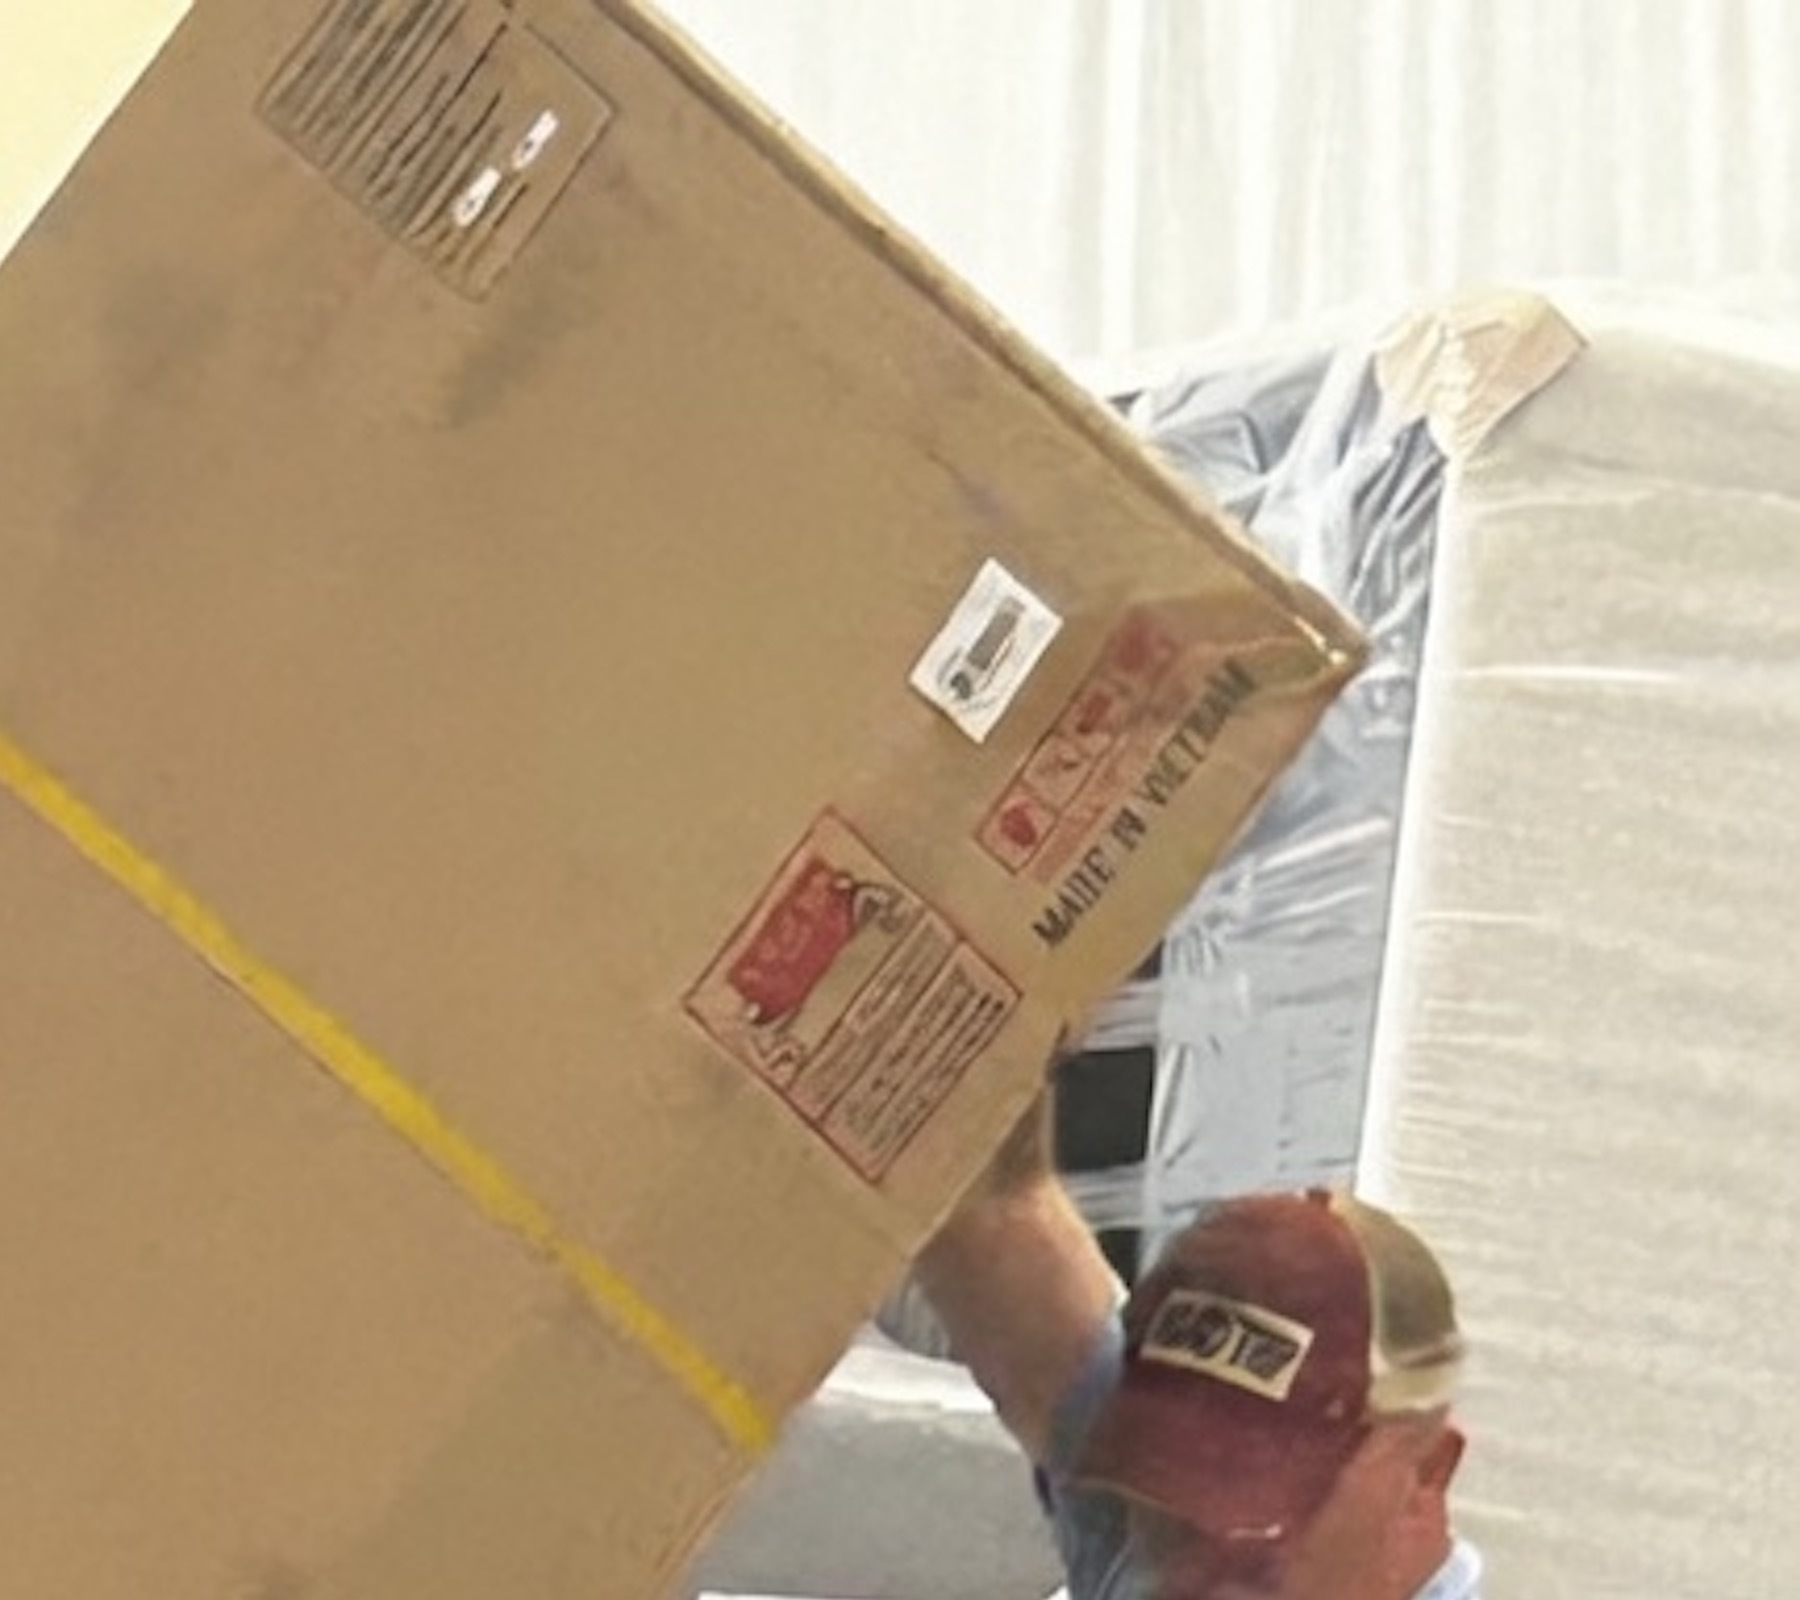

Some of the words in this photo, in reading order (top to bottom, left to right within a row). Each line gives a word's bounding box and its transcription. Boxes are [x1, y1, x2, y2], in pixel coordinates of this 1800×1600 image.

[1032, 847, 1116, 946] MADE
[1111, 806, 1146, 850] IN
[1132, 656, 1257, 806] VIETNAM
